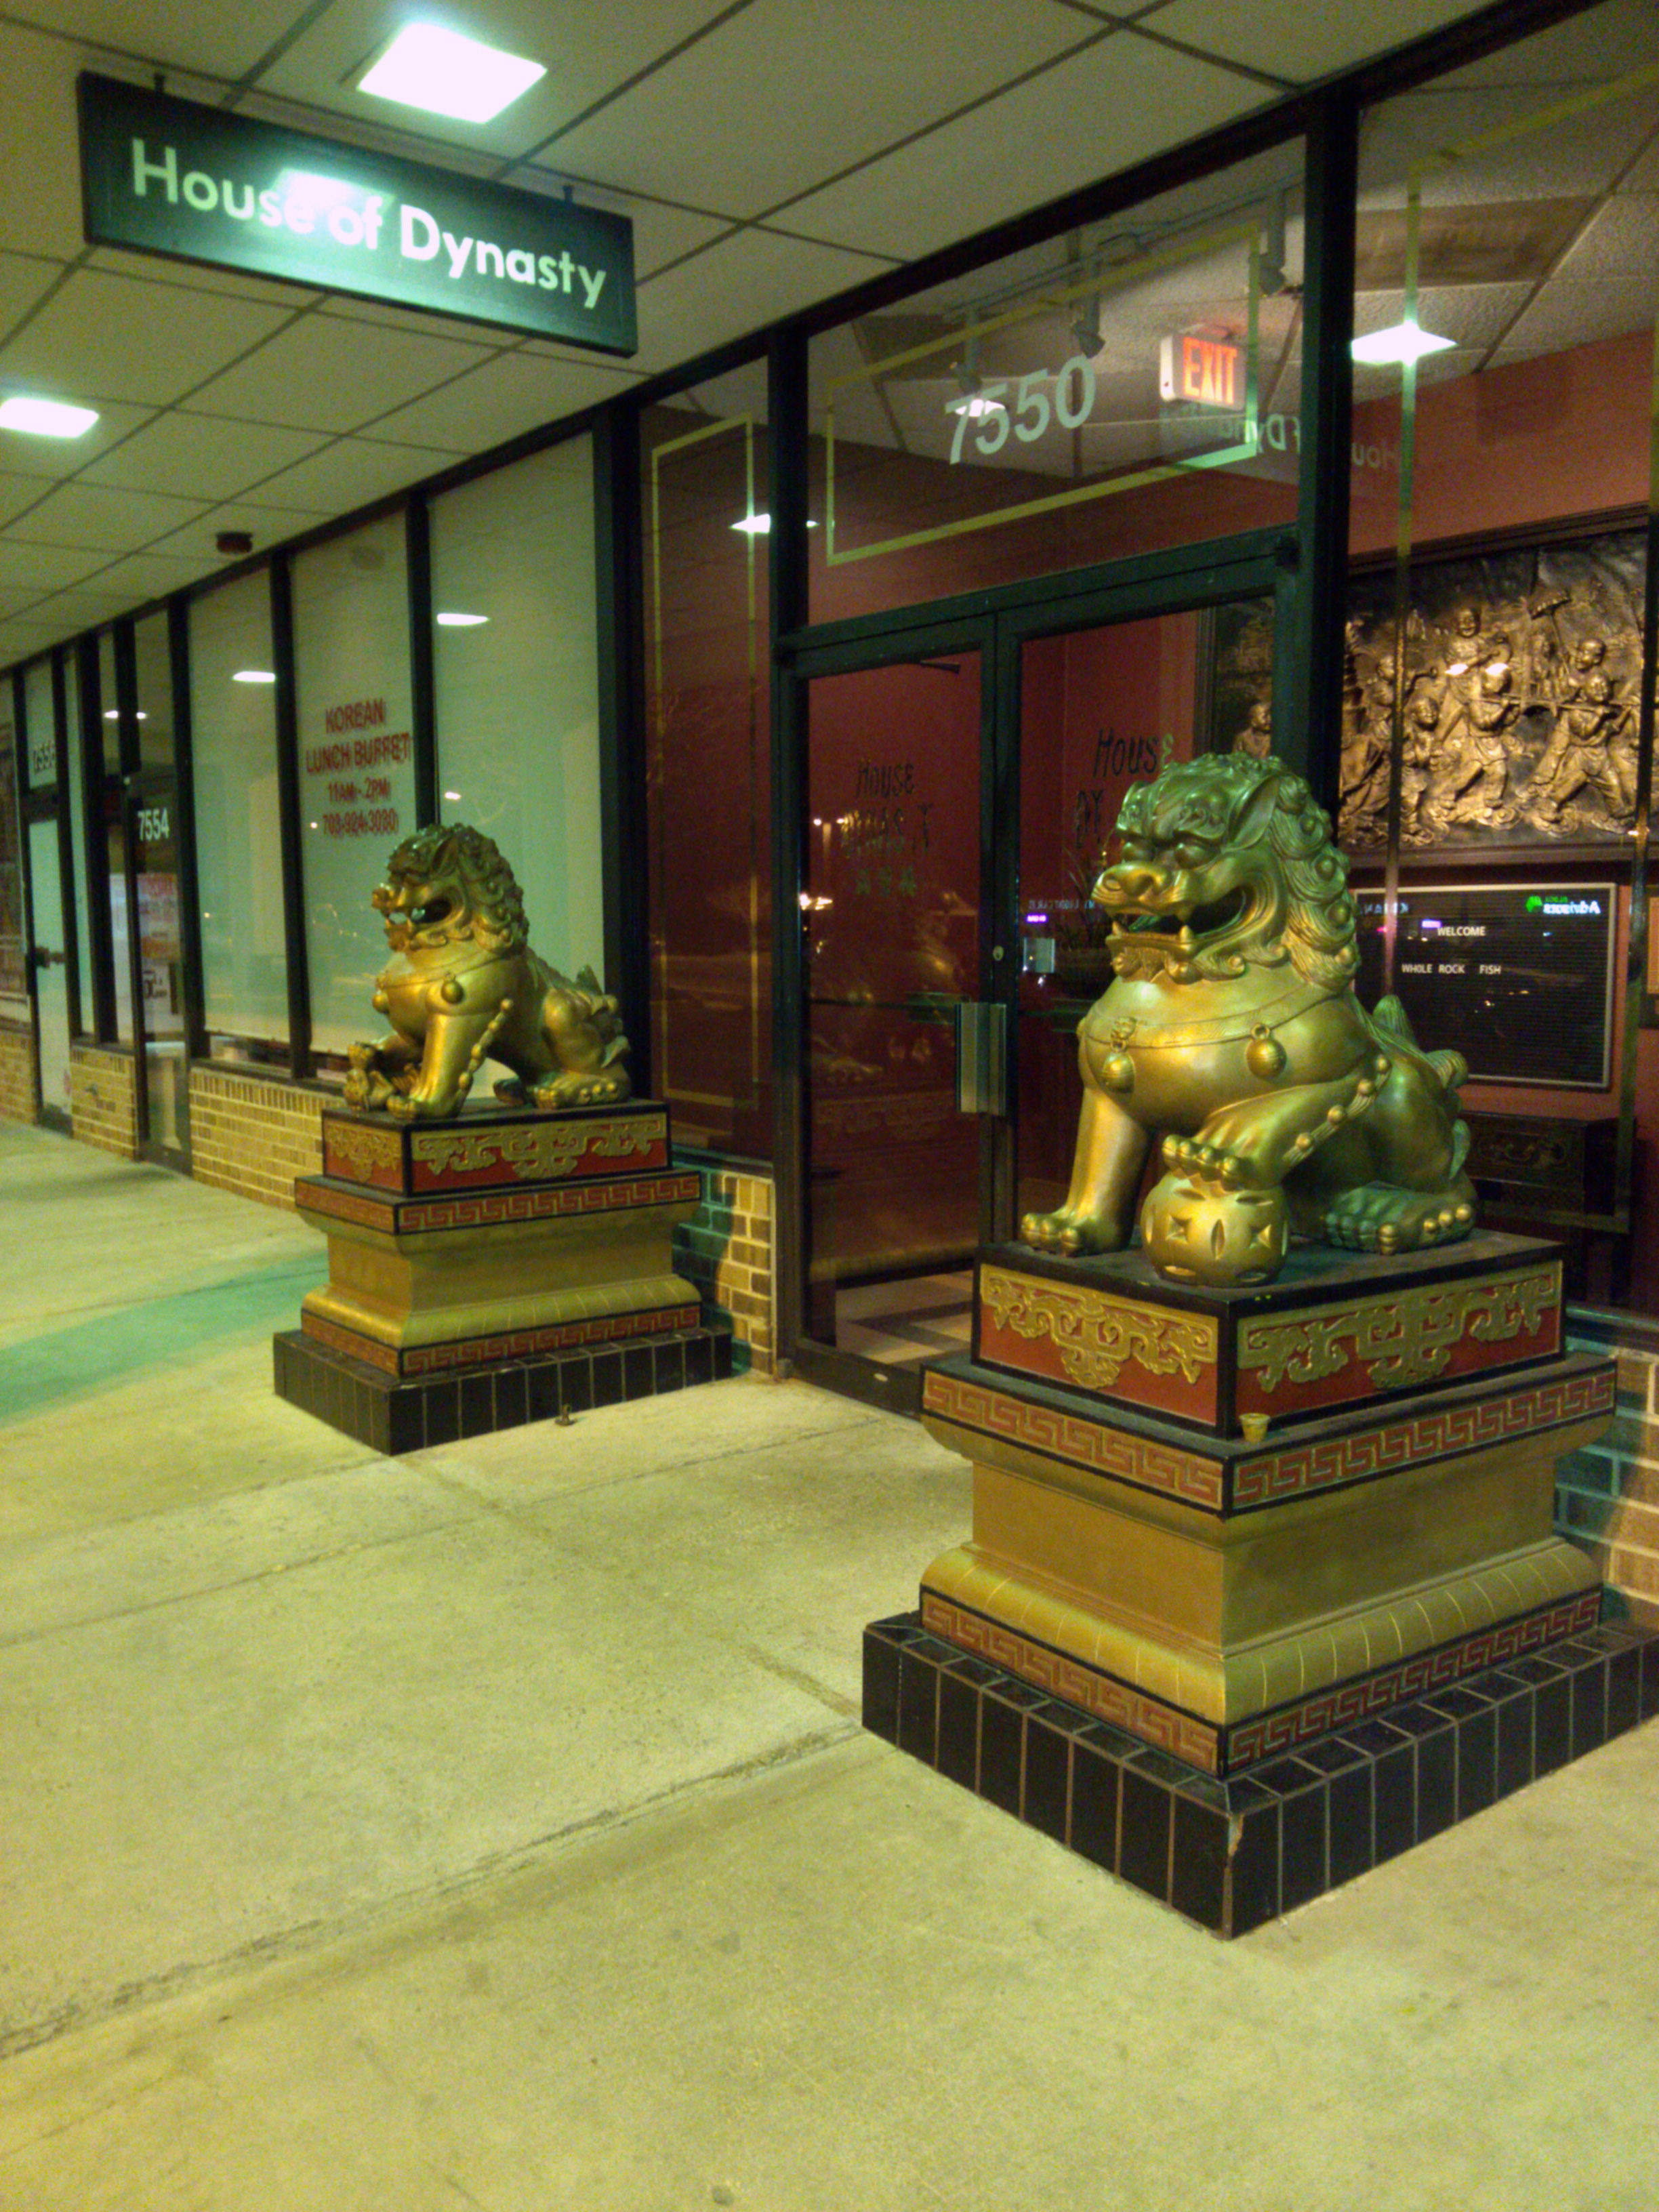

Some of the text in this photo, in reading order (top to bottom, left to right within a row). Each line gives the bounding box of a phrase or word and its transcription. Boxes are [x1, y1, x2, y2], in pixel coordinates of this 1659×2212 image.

[131, 138, 608, 309] House of Dynasty
[1183, 337, 1239, 406] EXIT
[944, 354, 1097, 465] 7550
[325, 697, 387, 733] KOREAN
[305, 731, 412, 773] LUNCH BUFFET
[329, 781, 356, 803] 11AM
[364, 777, 390, 802] 2PM
[137, 807, 170, 842] 7554
[1437, 926, 1486, 937] WELCOME
[1401, 964, 1502, 975] WHOLE ROCK FISH
